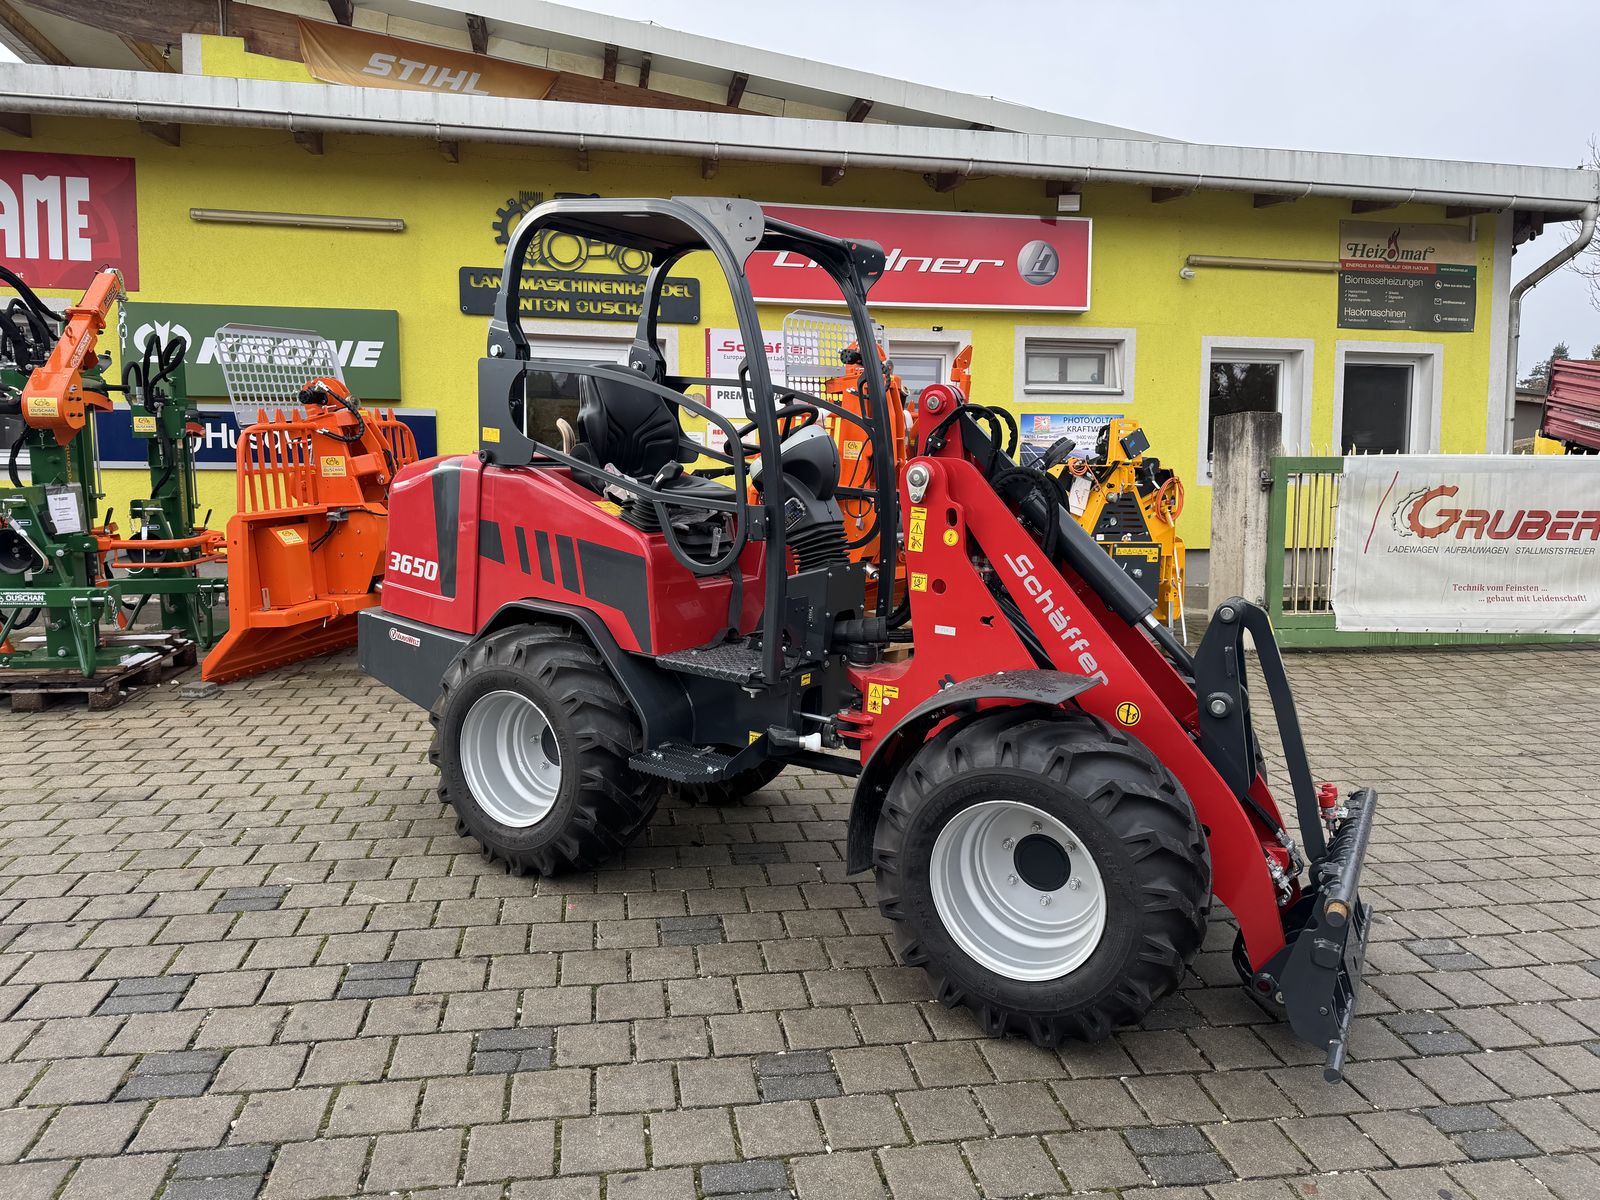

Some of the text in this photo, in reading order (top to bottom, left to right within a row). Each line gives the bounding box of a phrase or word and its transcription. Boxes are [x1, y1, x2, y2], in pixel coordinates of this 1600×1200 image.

[362, 52, 490, 96] STIHL
[1344, 275, 1424, 288] Biomasseheizungen
[1344, 307, 1407, 318] Hackmaschinen
[1408, 485, 1600, 542] GRUBER
[1387, 545, 1596, 556] LADEWAGEN AUFBAUWAGEN STALLMISTSTREUER
[388, 551, 439, 581] 3650
[1453, 584, 1485, 592] Technik
[1505, 584, 1539, 592] Feinsten
[5, 594, 44, 602] OUSCHAN
[1486, 595, 1514, 603] gebaut
[1532, 595, 1588, 603] Leidenschaft!
[1003, 553, 1109, 687] Schäffer
